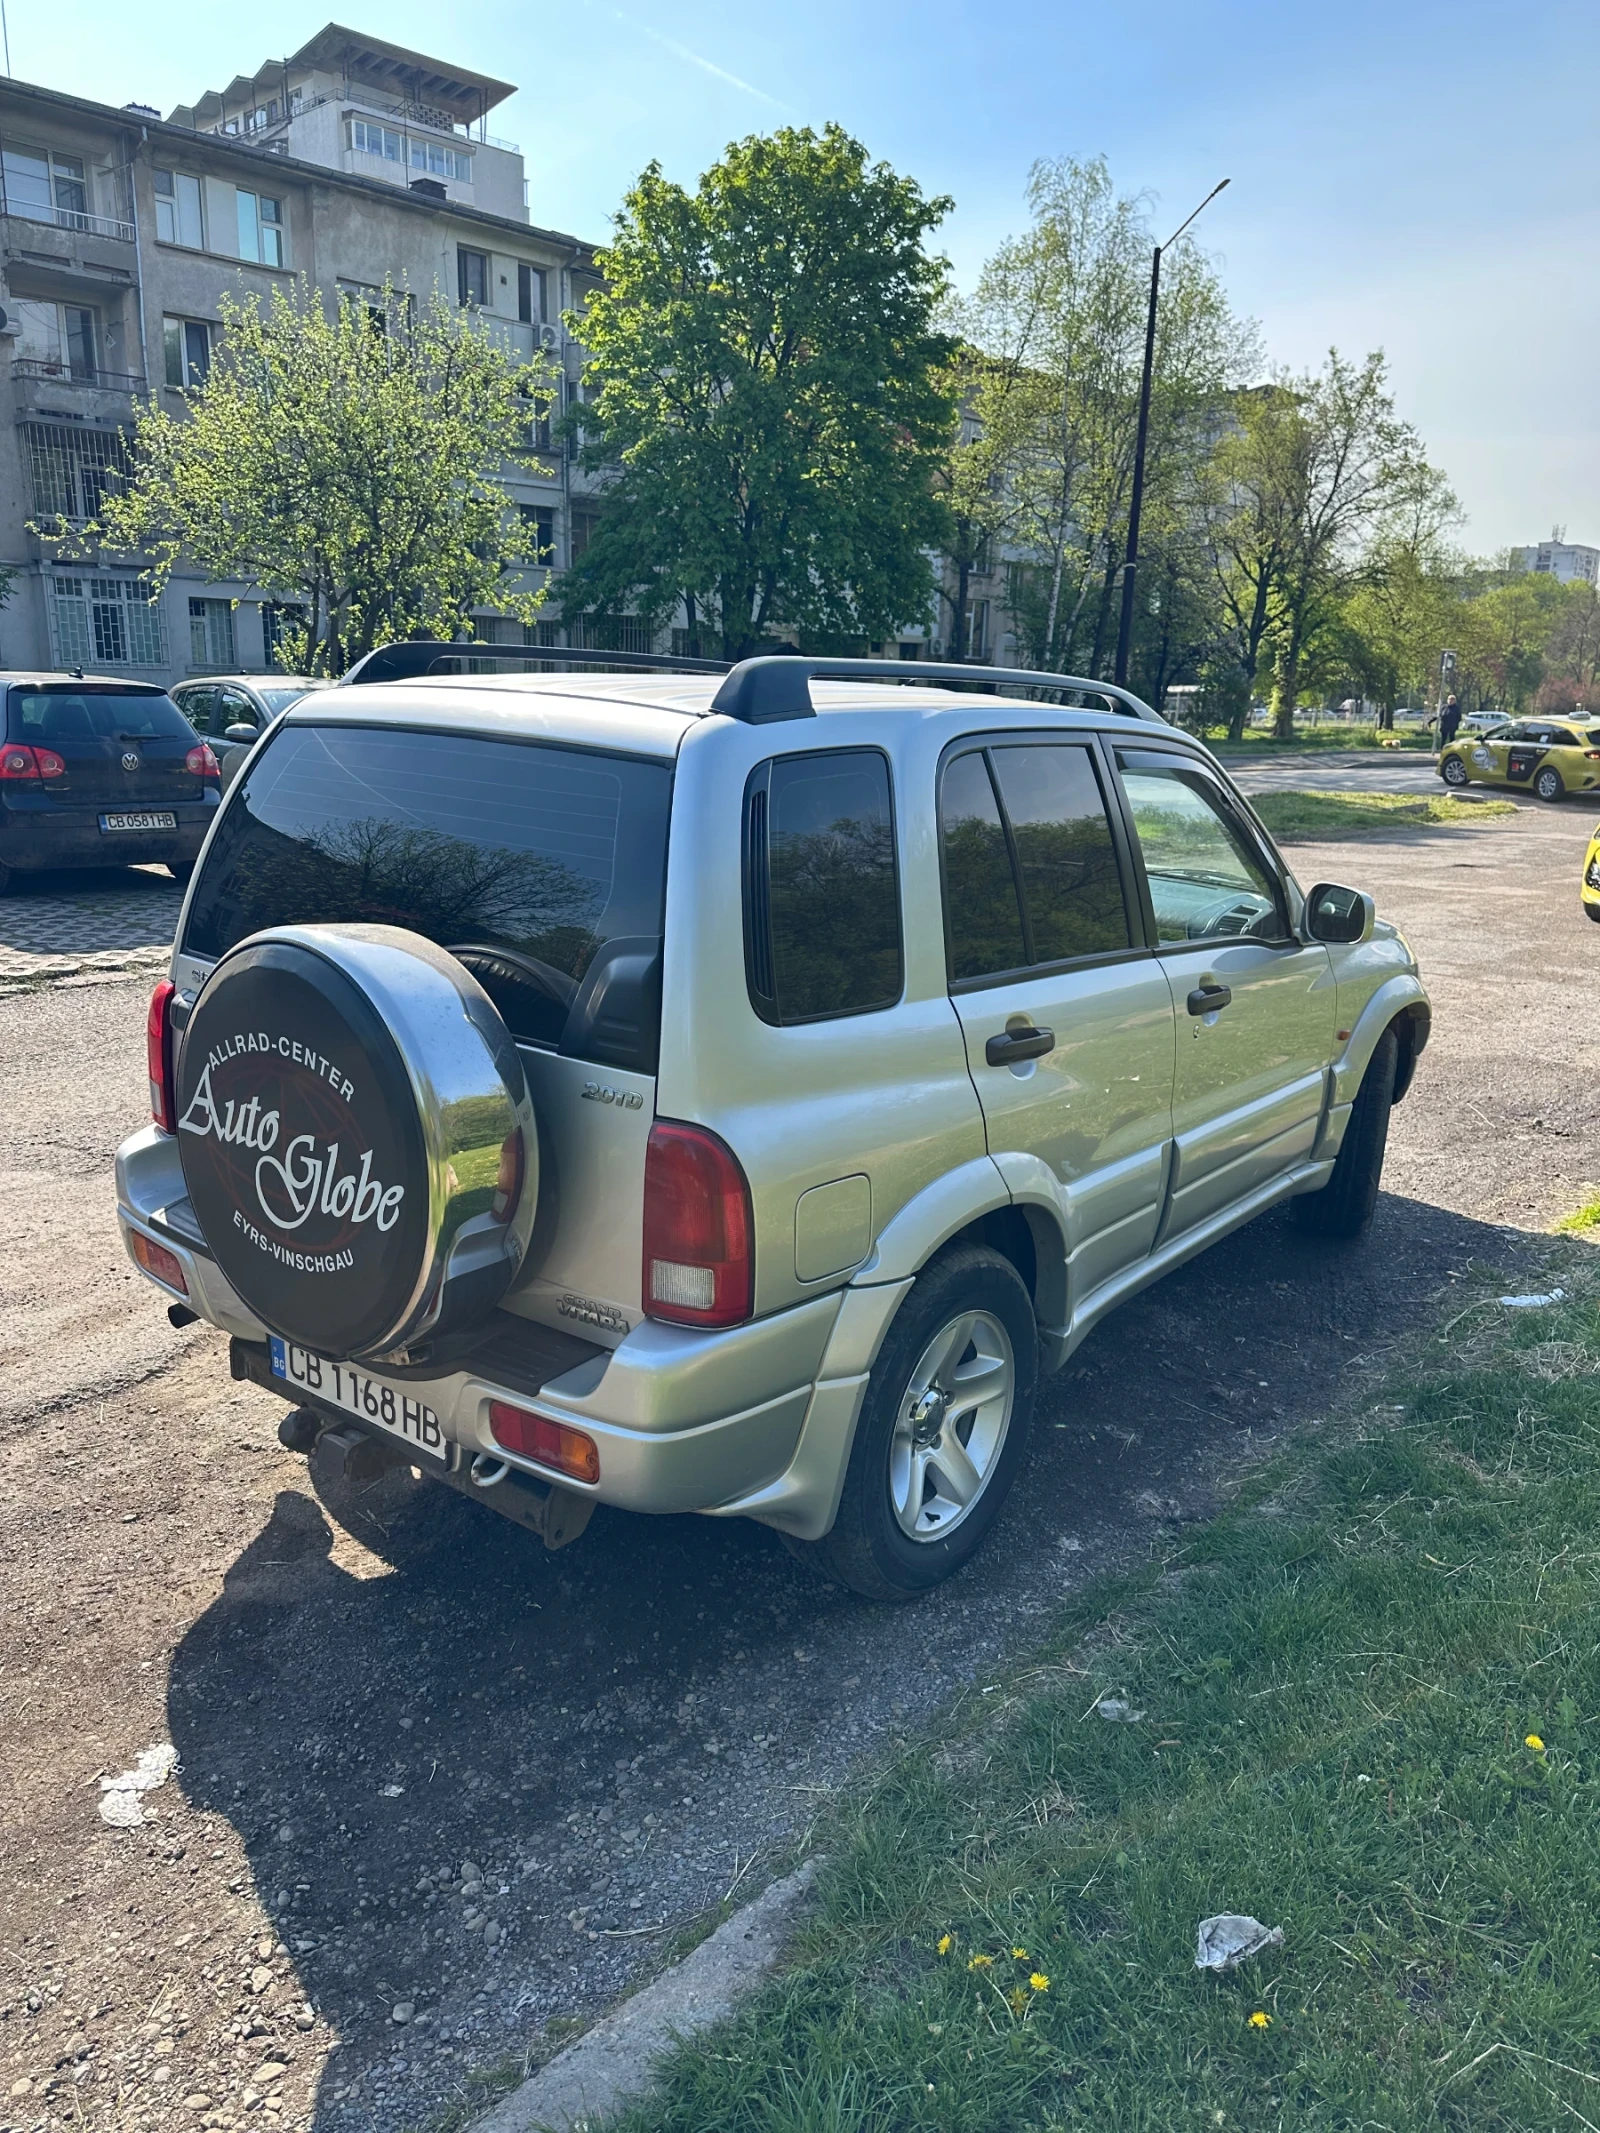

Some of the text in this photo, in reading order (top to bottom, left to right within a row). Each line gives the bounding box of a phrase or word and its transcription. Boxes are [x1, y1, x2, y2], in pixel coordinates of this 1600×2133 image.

[107, 815, 126, 828] CB
[127, 814, 157, 828] 0581
[158, 813, 174, 826] HB
[208, 1032, 355, 1103] ALLRAD-CENTER
[178, 1062, 405, 1232] Auto Globe
[232, 1209, 354, 1274] EYRS-VINSCHGAU
[556, 1299, 631, 1336] VITARA
[563, 1293, 622, 1319] GRAND
[273, 1344, 441, 1449] BG CB 1168 HB
